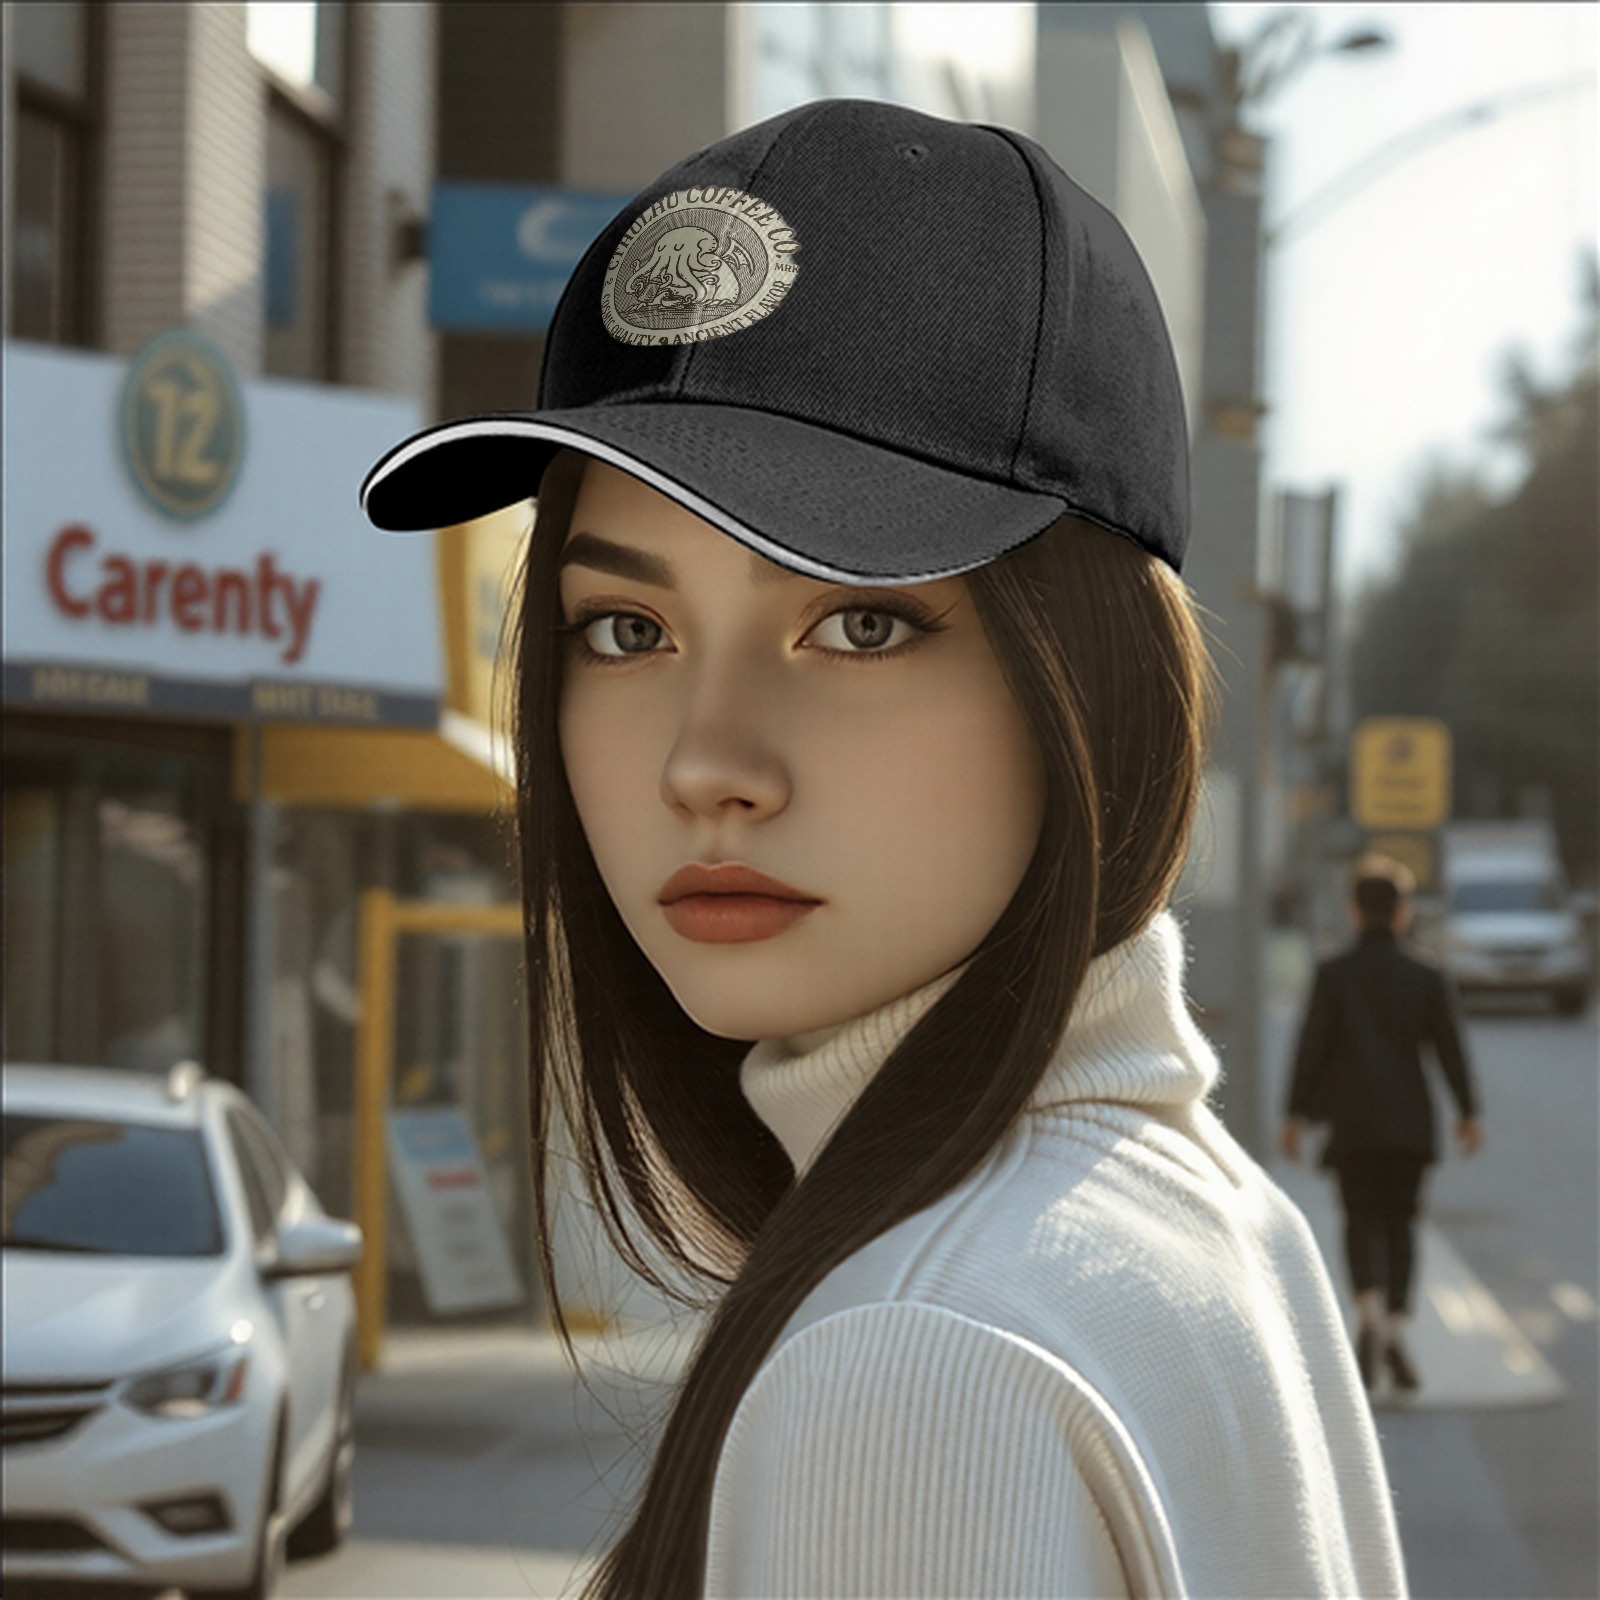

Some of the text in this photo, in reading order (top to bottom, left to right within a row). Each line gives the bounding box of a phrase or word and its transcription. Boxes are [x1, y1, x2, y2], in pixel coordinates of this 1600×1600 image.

[608, 191, 679, 271] CTHULHU
[685, 185, 782, 228] COFFEE
[611, 325, 657, 346] QUALITY
[672, 317, 748, 345] ANCIENT
[743, 279, 792, 325] FLAVOR
[45, 523, 320, 665] Carenty
